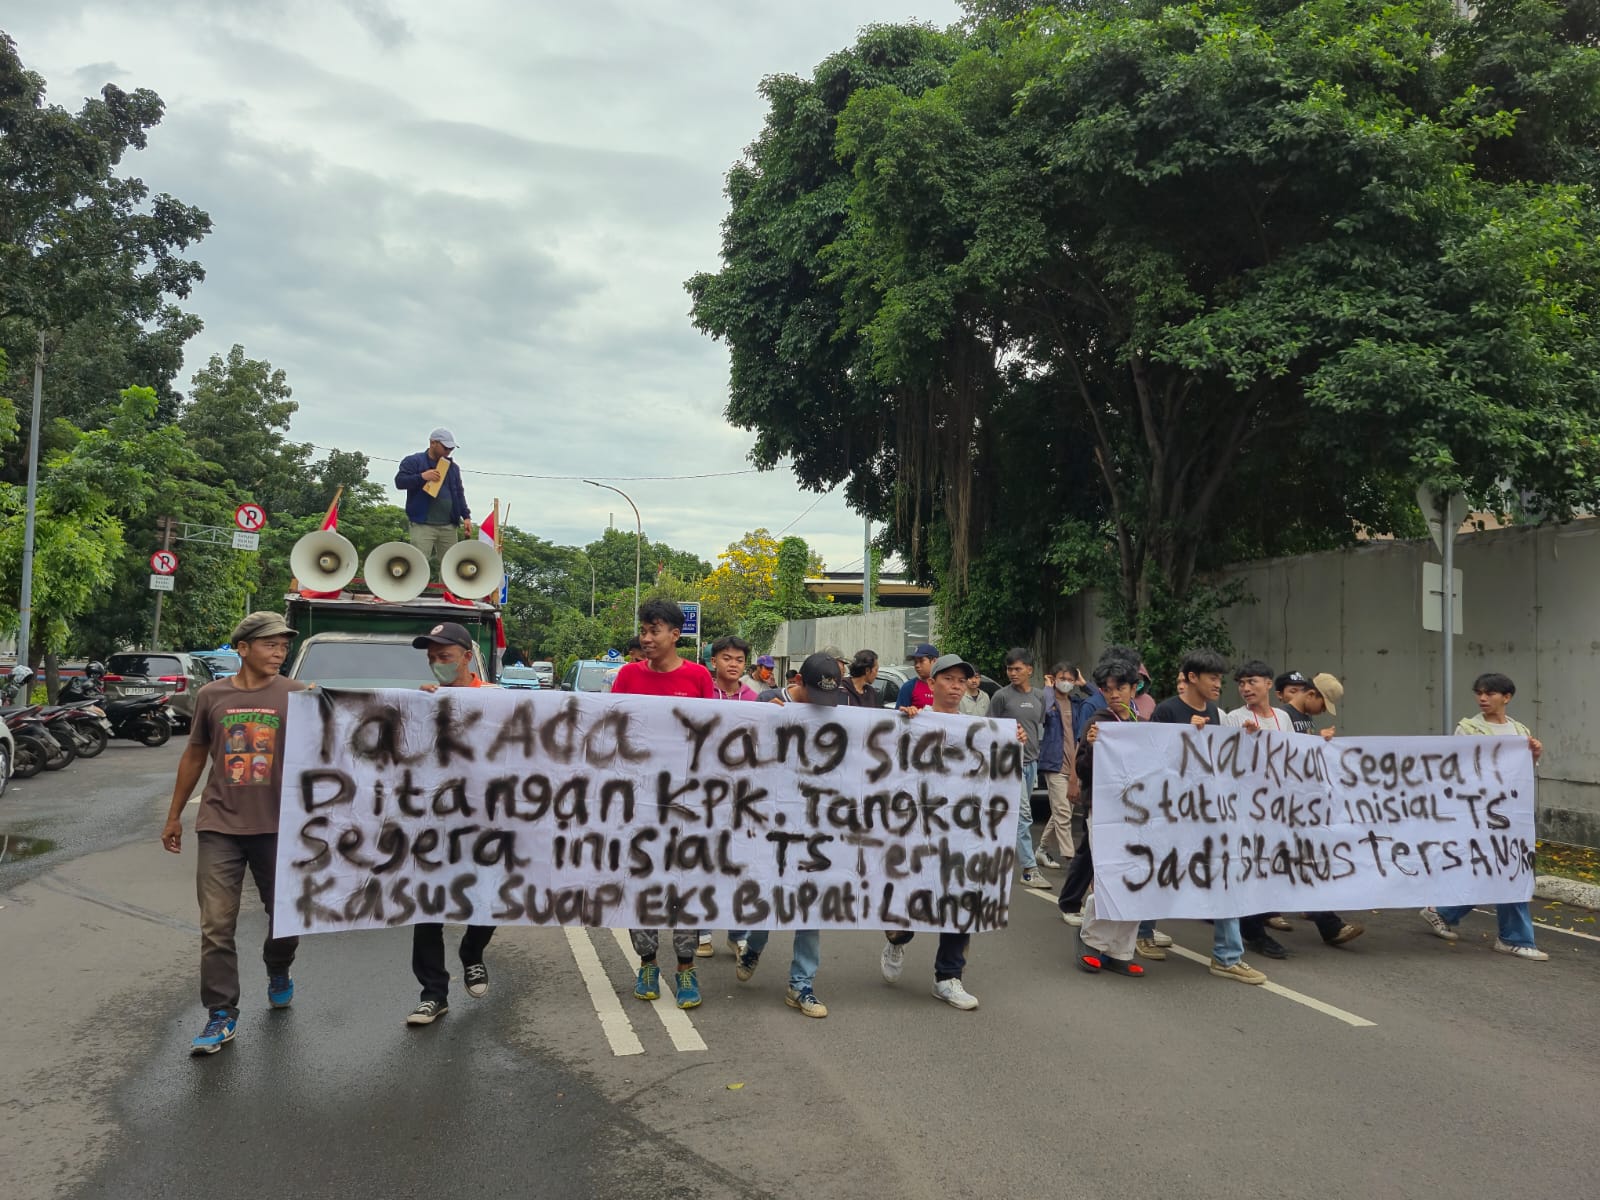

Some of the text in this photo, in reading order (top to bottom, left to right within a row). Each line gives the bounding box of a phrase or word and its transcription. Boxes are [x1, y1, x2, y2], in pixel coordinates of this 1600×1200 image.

[219, 711, 280, 729] TURTLES
[672, 707, 848, 775] Yang
[1179, 730, 1333, 788] Naikkan
[300, 768, 635, 825] Ditangan
[799, 781, 1010, 841] Tangkap
[1122, 779, 1238, 825] Status
[291, 816, 531, 875] Segera
[1122, 833, 1229, 892] Jadi
